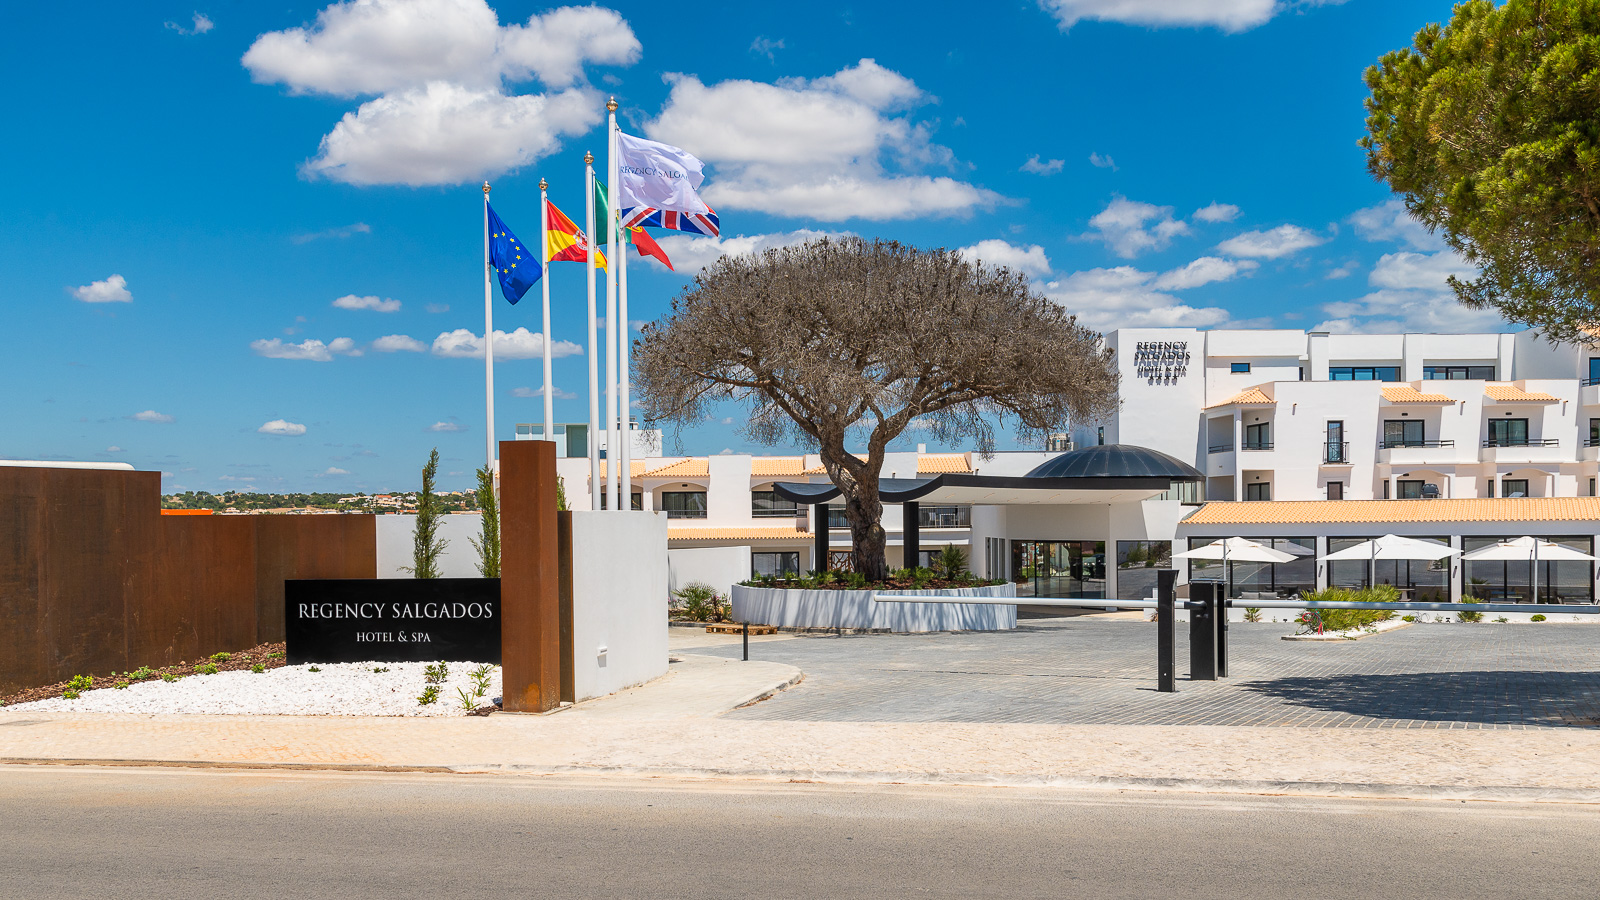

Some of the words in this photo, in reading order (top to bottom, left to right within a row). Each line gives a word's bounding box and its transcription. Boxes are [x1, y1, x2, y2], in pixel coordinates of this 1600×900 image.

[619, 165, 657, 176] REGENCY
[1136, 341, 1188, 350] REGENCY
[1134, 351, 1191, 361] SALGADOS
[1137, 365, 1163, 373] HOTEL
[298, 602, 386, 619] REGENCY
[392, 602, 493, 619] SALGADOS
[356, 631, 395, 642] HOTEL
[397, 630, 408, 642] &
[411, 631, 431, 642] SPA
